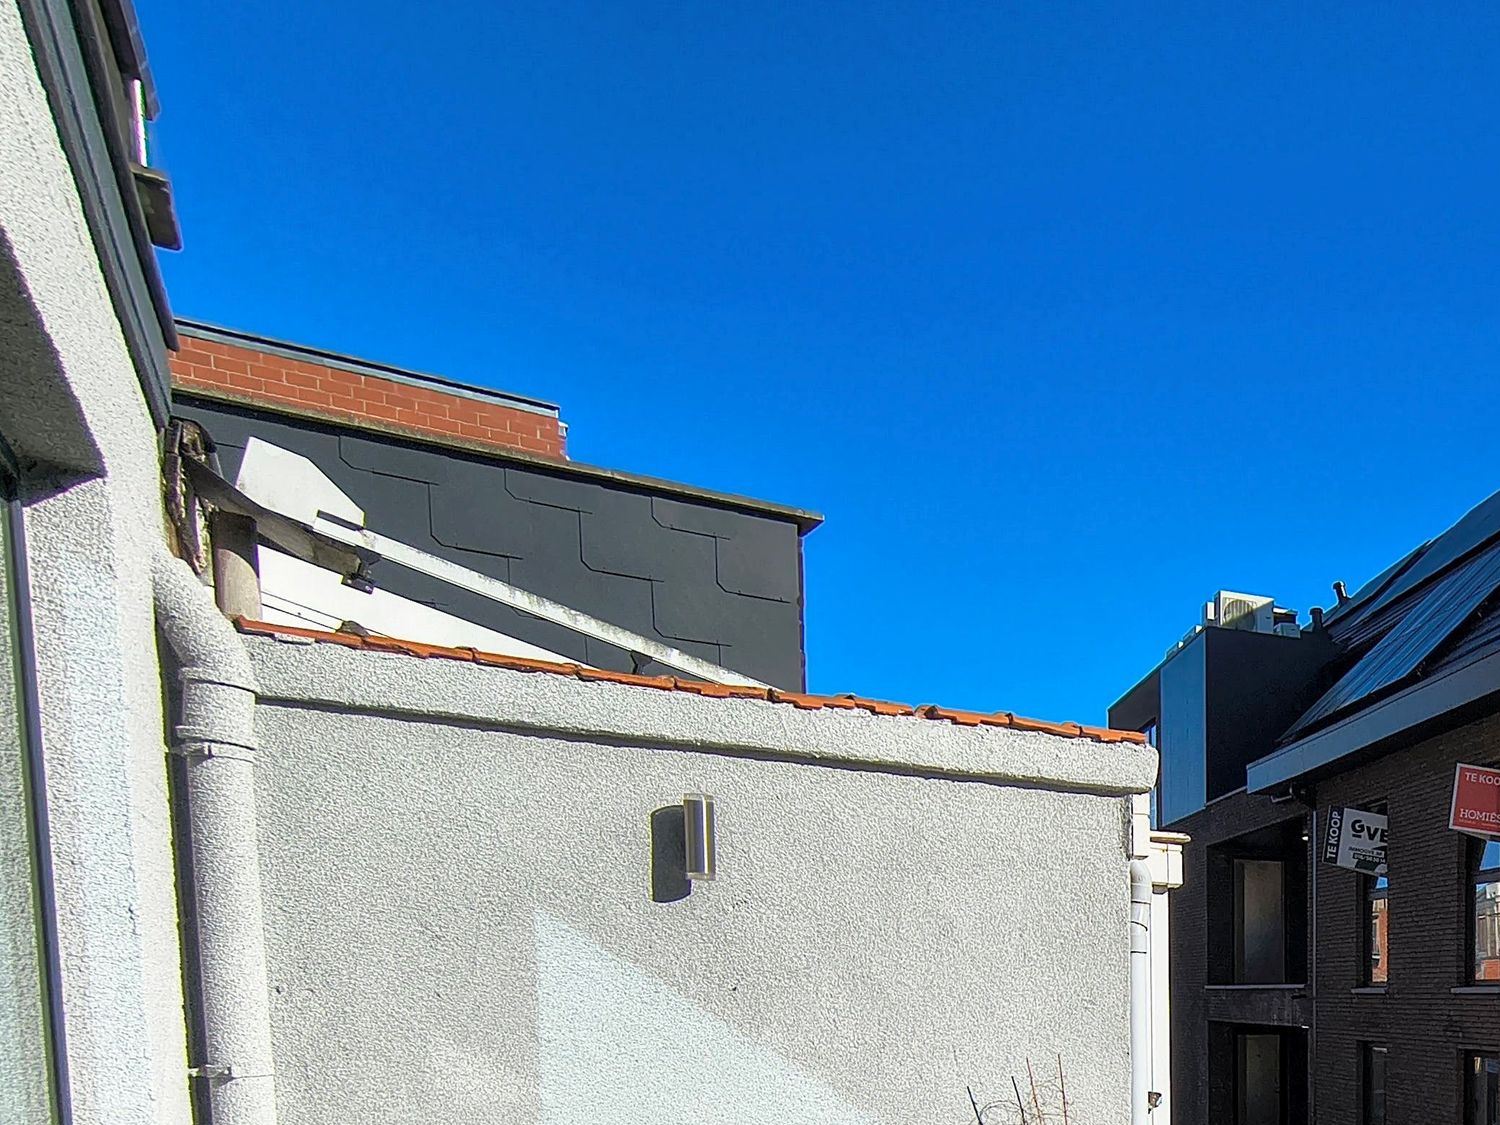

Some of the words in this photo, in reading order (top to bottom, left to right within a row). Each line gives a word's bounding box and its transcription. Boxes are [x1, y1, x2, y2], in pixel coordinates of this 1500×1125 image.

[1465, 772, 1478, 783] TE
[1328, 811, 1341, 844] KOOP
[1326, 845, 1337, 858] TE
